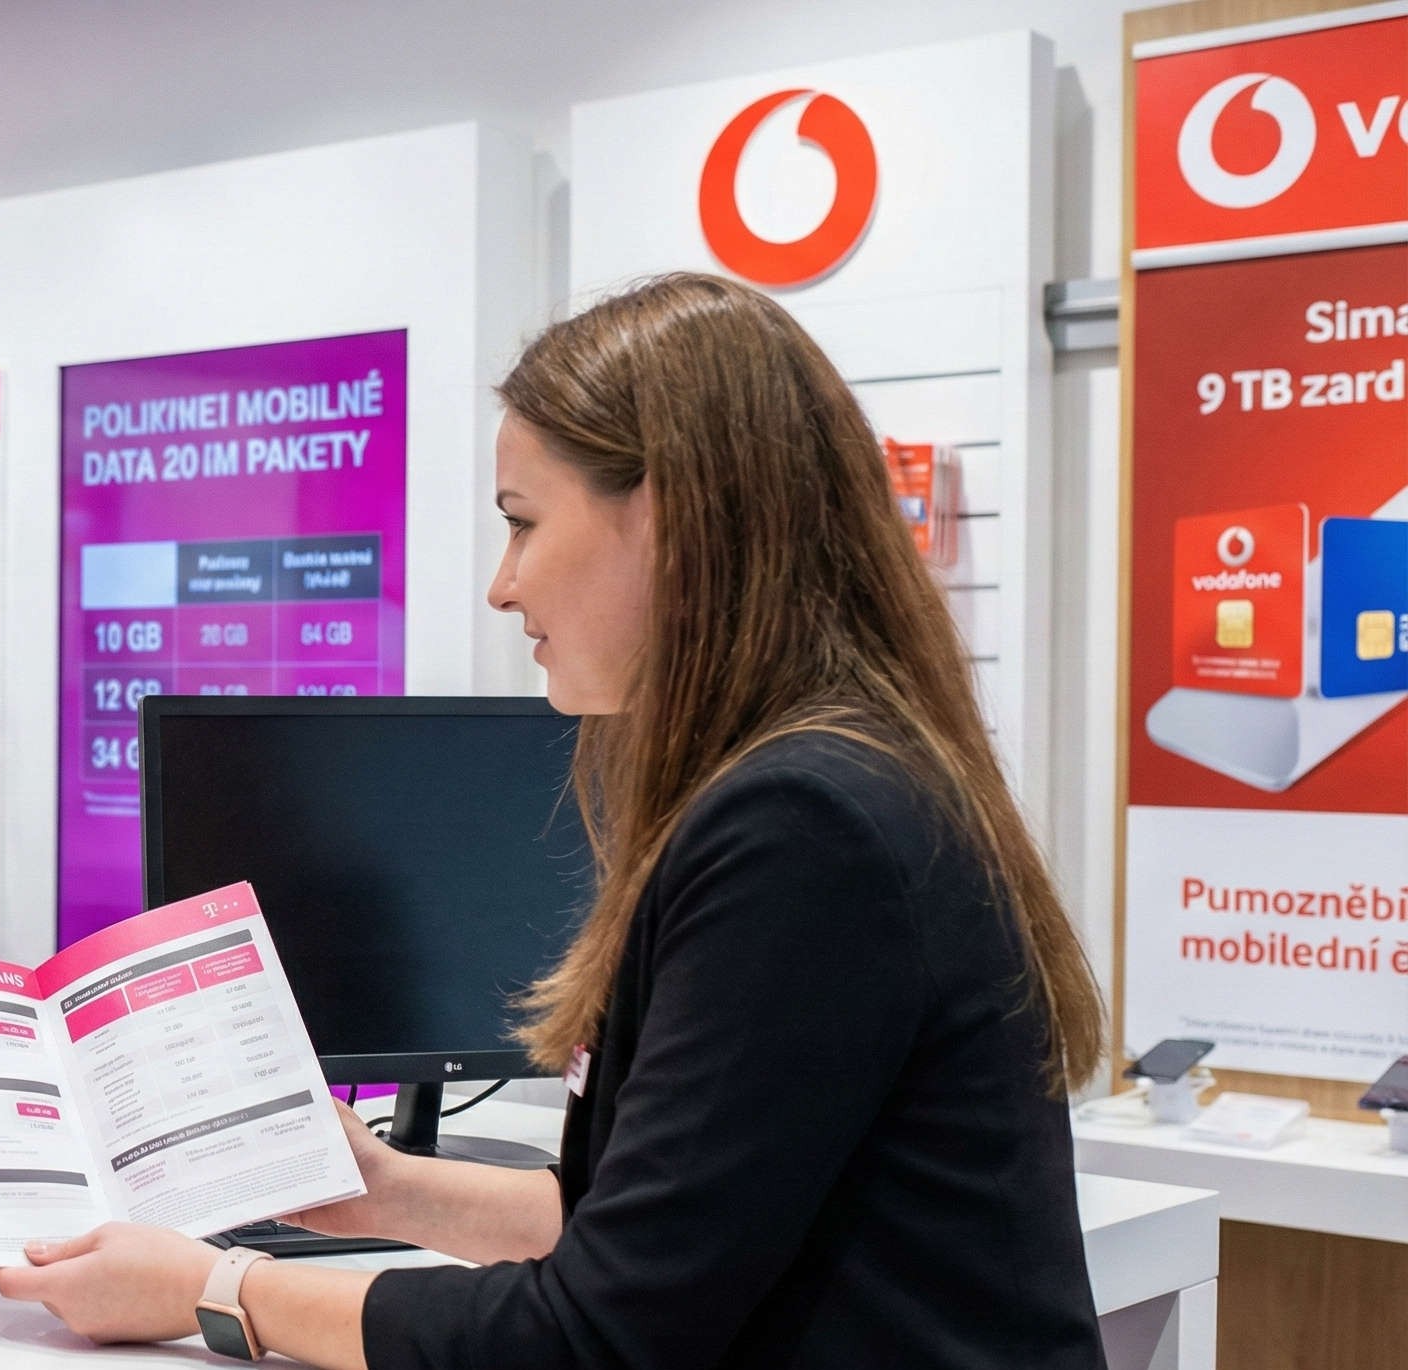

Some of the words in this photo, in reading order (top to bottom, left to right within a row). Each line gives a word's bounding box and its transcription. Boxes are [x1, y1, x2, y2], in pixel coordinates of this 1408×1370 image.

[1336, 95, 1408, 158] v
[237, 369, 383, 426] MOBILNÉ
[1197, 373, 1226, 415] 9
[1232, 368, 1293, 411] TB
[1300, 359, 1405, 407] zard
[83, 447, 157, 486] DATA
[246, 430, 371, 475] PAKETY
[1192, 568, 1282, 591] vodafone
[94, 621, 123, 652] 10
[126, 620, 163, 652] GB
[94, 678, 122, 711] 12
[92, 736, 121, 770] 34
[1180, 931, 1381, 973] mobilední
